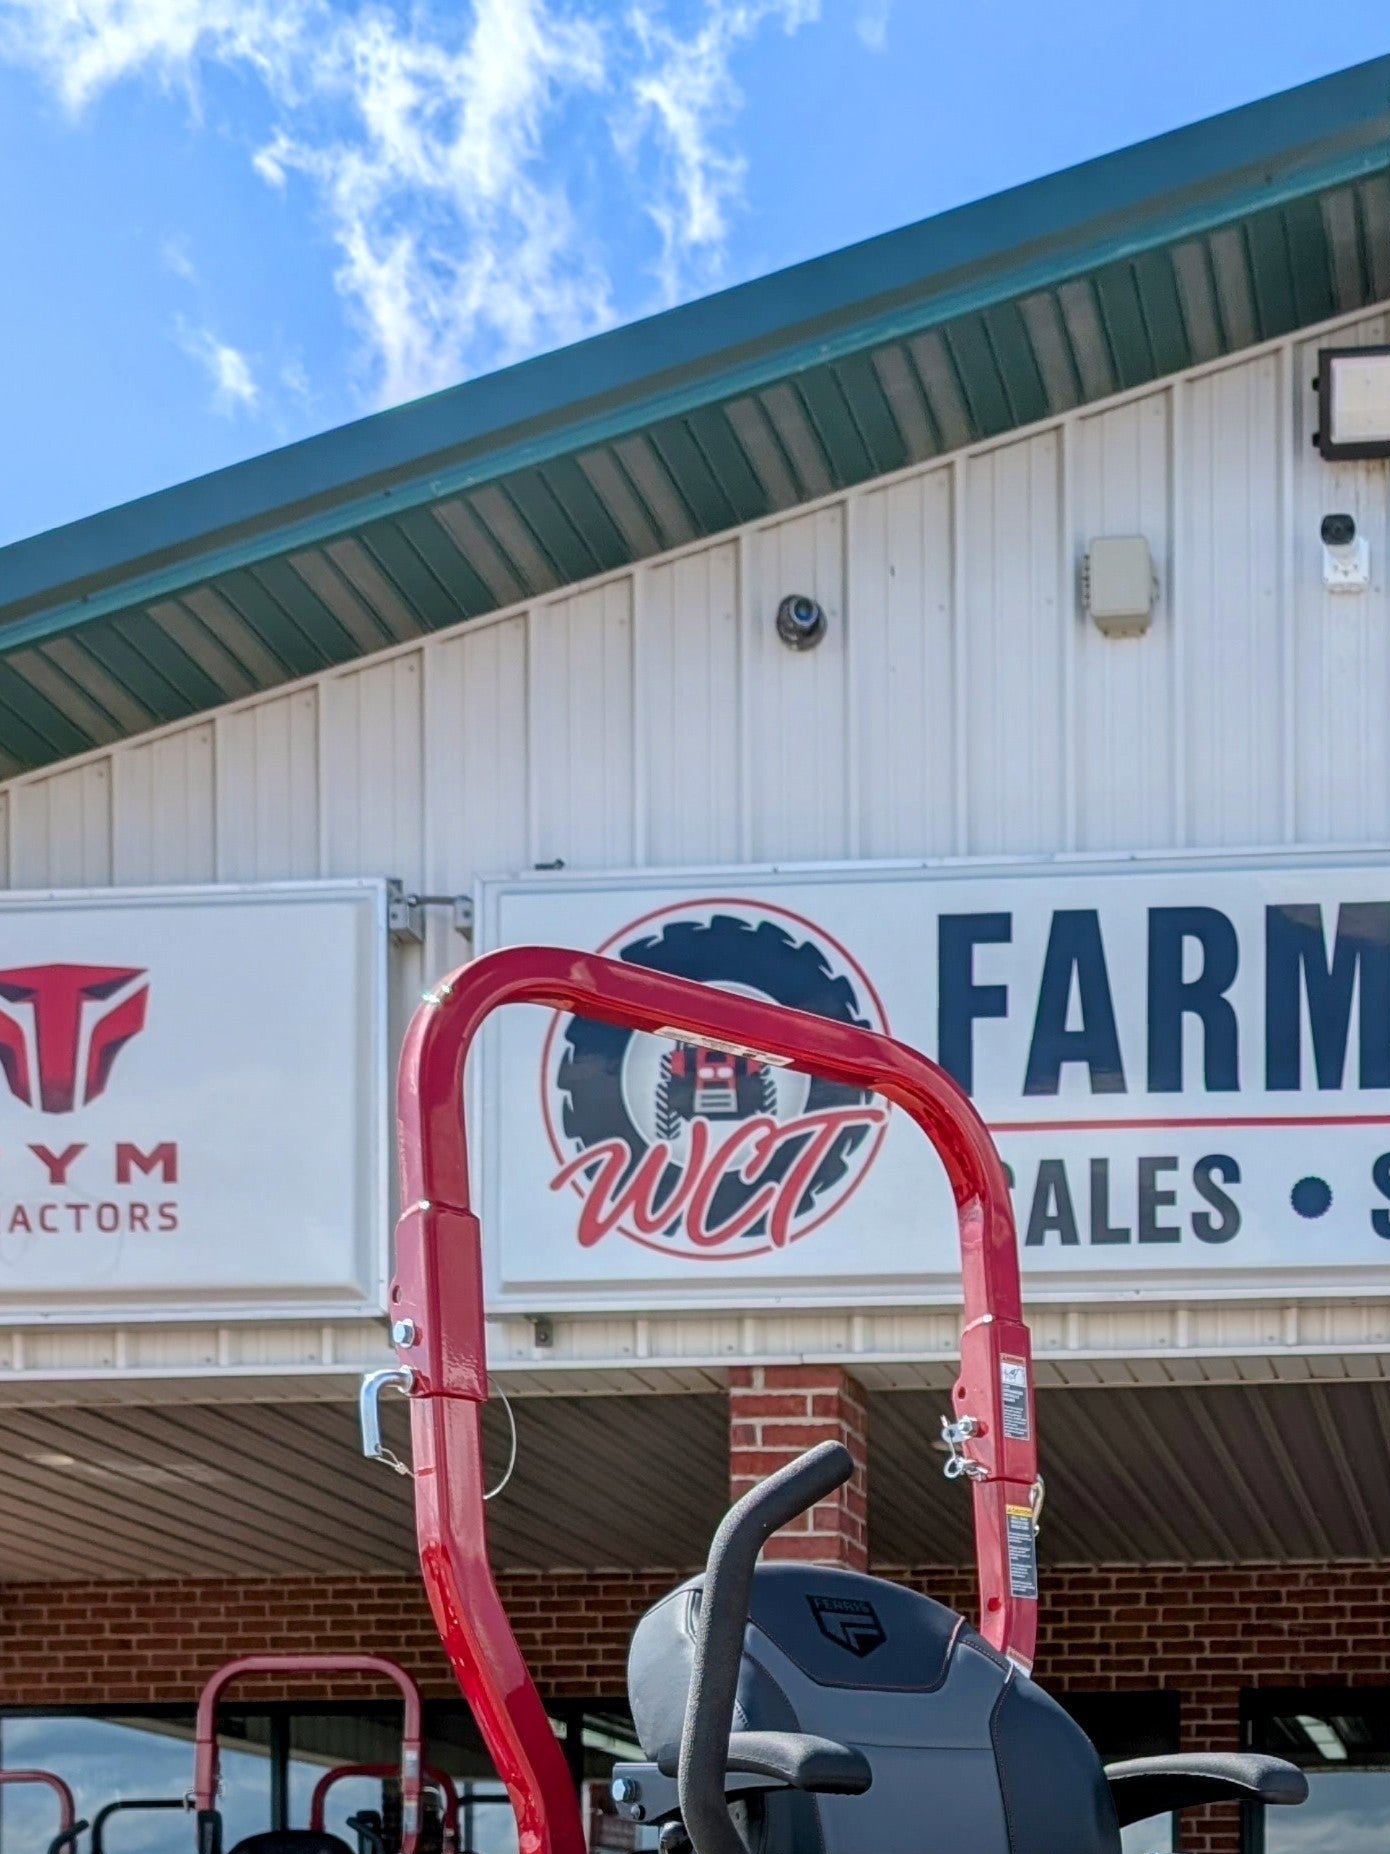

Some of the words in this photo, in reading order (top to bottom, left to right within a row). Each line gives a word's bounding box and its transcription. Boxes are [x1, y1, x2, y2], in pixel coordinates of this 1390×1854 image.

[8, 1202, 180, 1234] ACTORS
[549, 1107, 887, 1249] WCT
[1002, 1152, 1242, 1247] ALES
